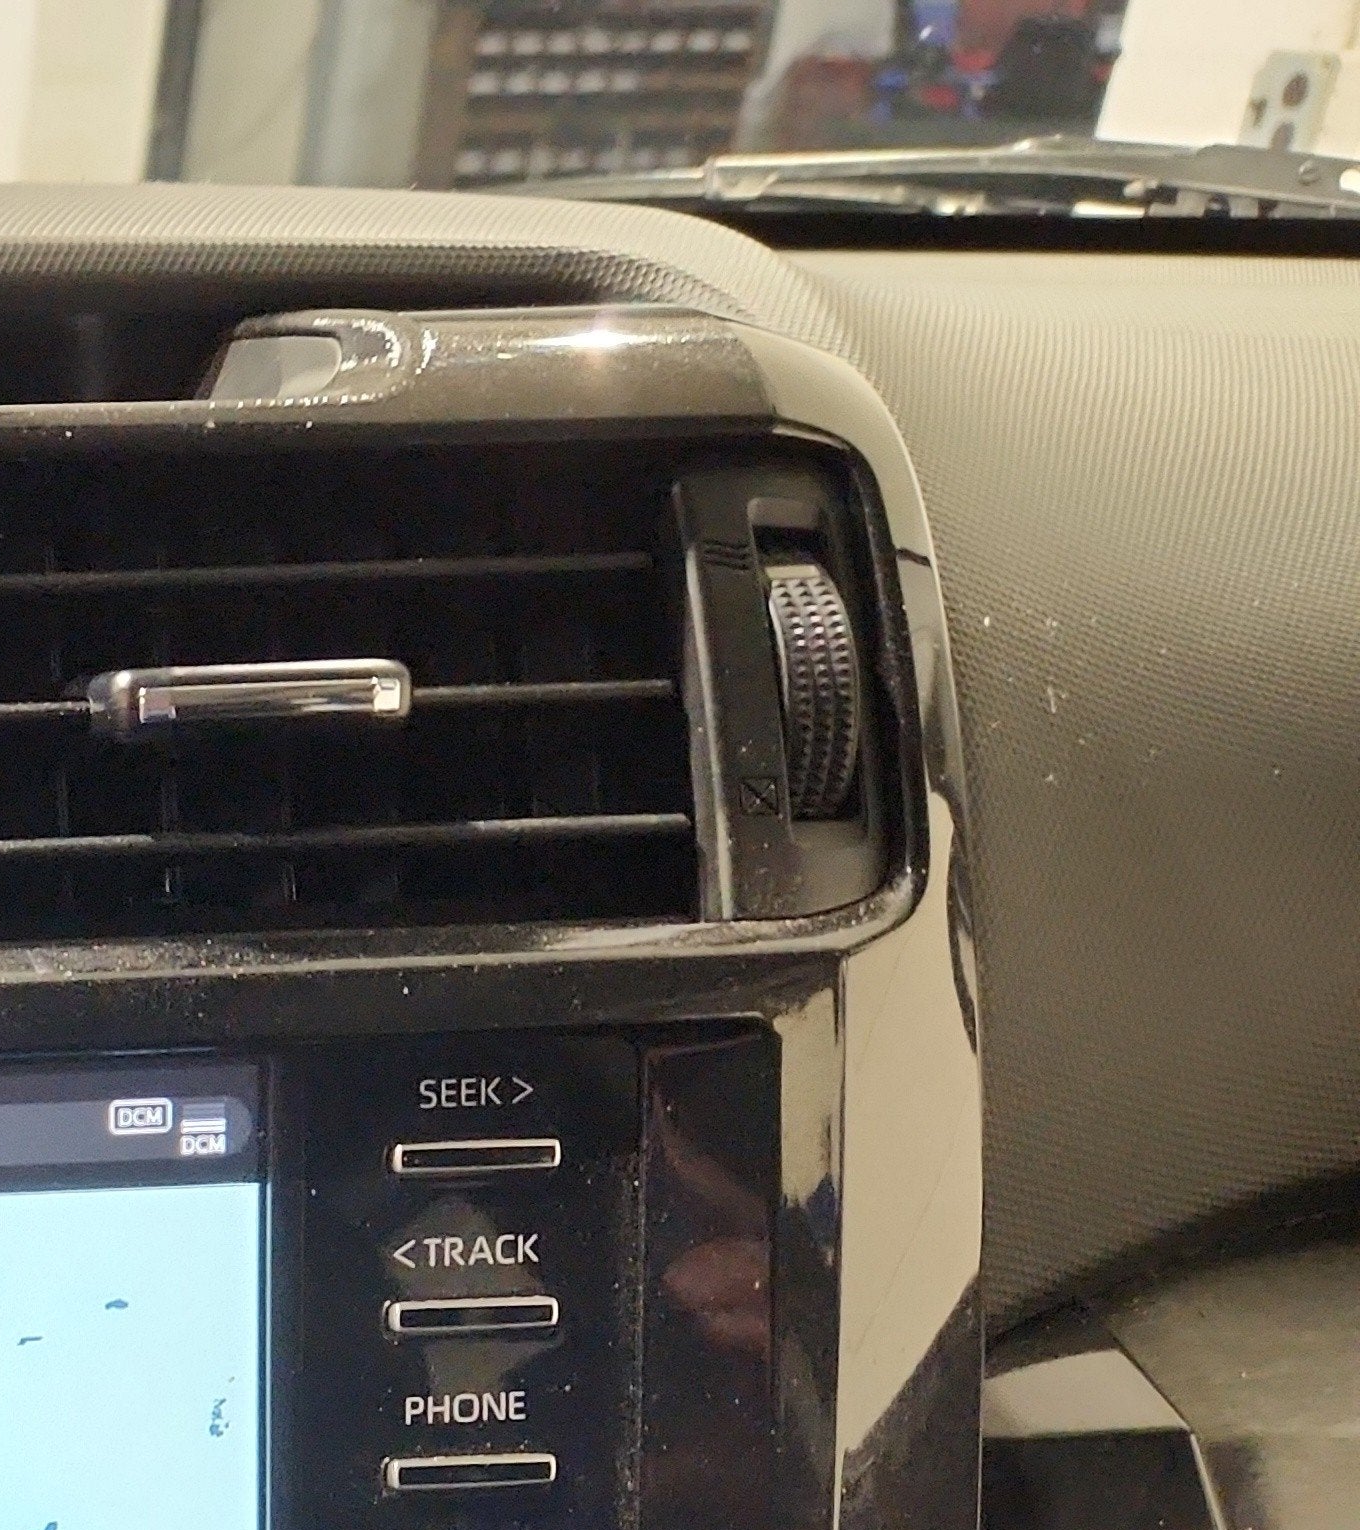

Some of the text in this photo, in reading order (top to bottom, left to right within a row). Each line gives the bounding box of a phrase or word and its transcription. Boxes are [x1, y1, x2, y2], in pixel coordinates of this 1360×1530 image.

[117, 1106, 163, 1127] DCM
[180, 1133, 226, 1156] DCM
[405, 1391, 526, 1426] PHONE
